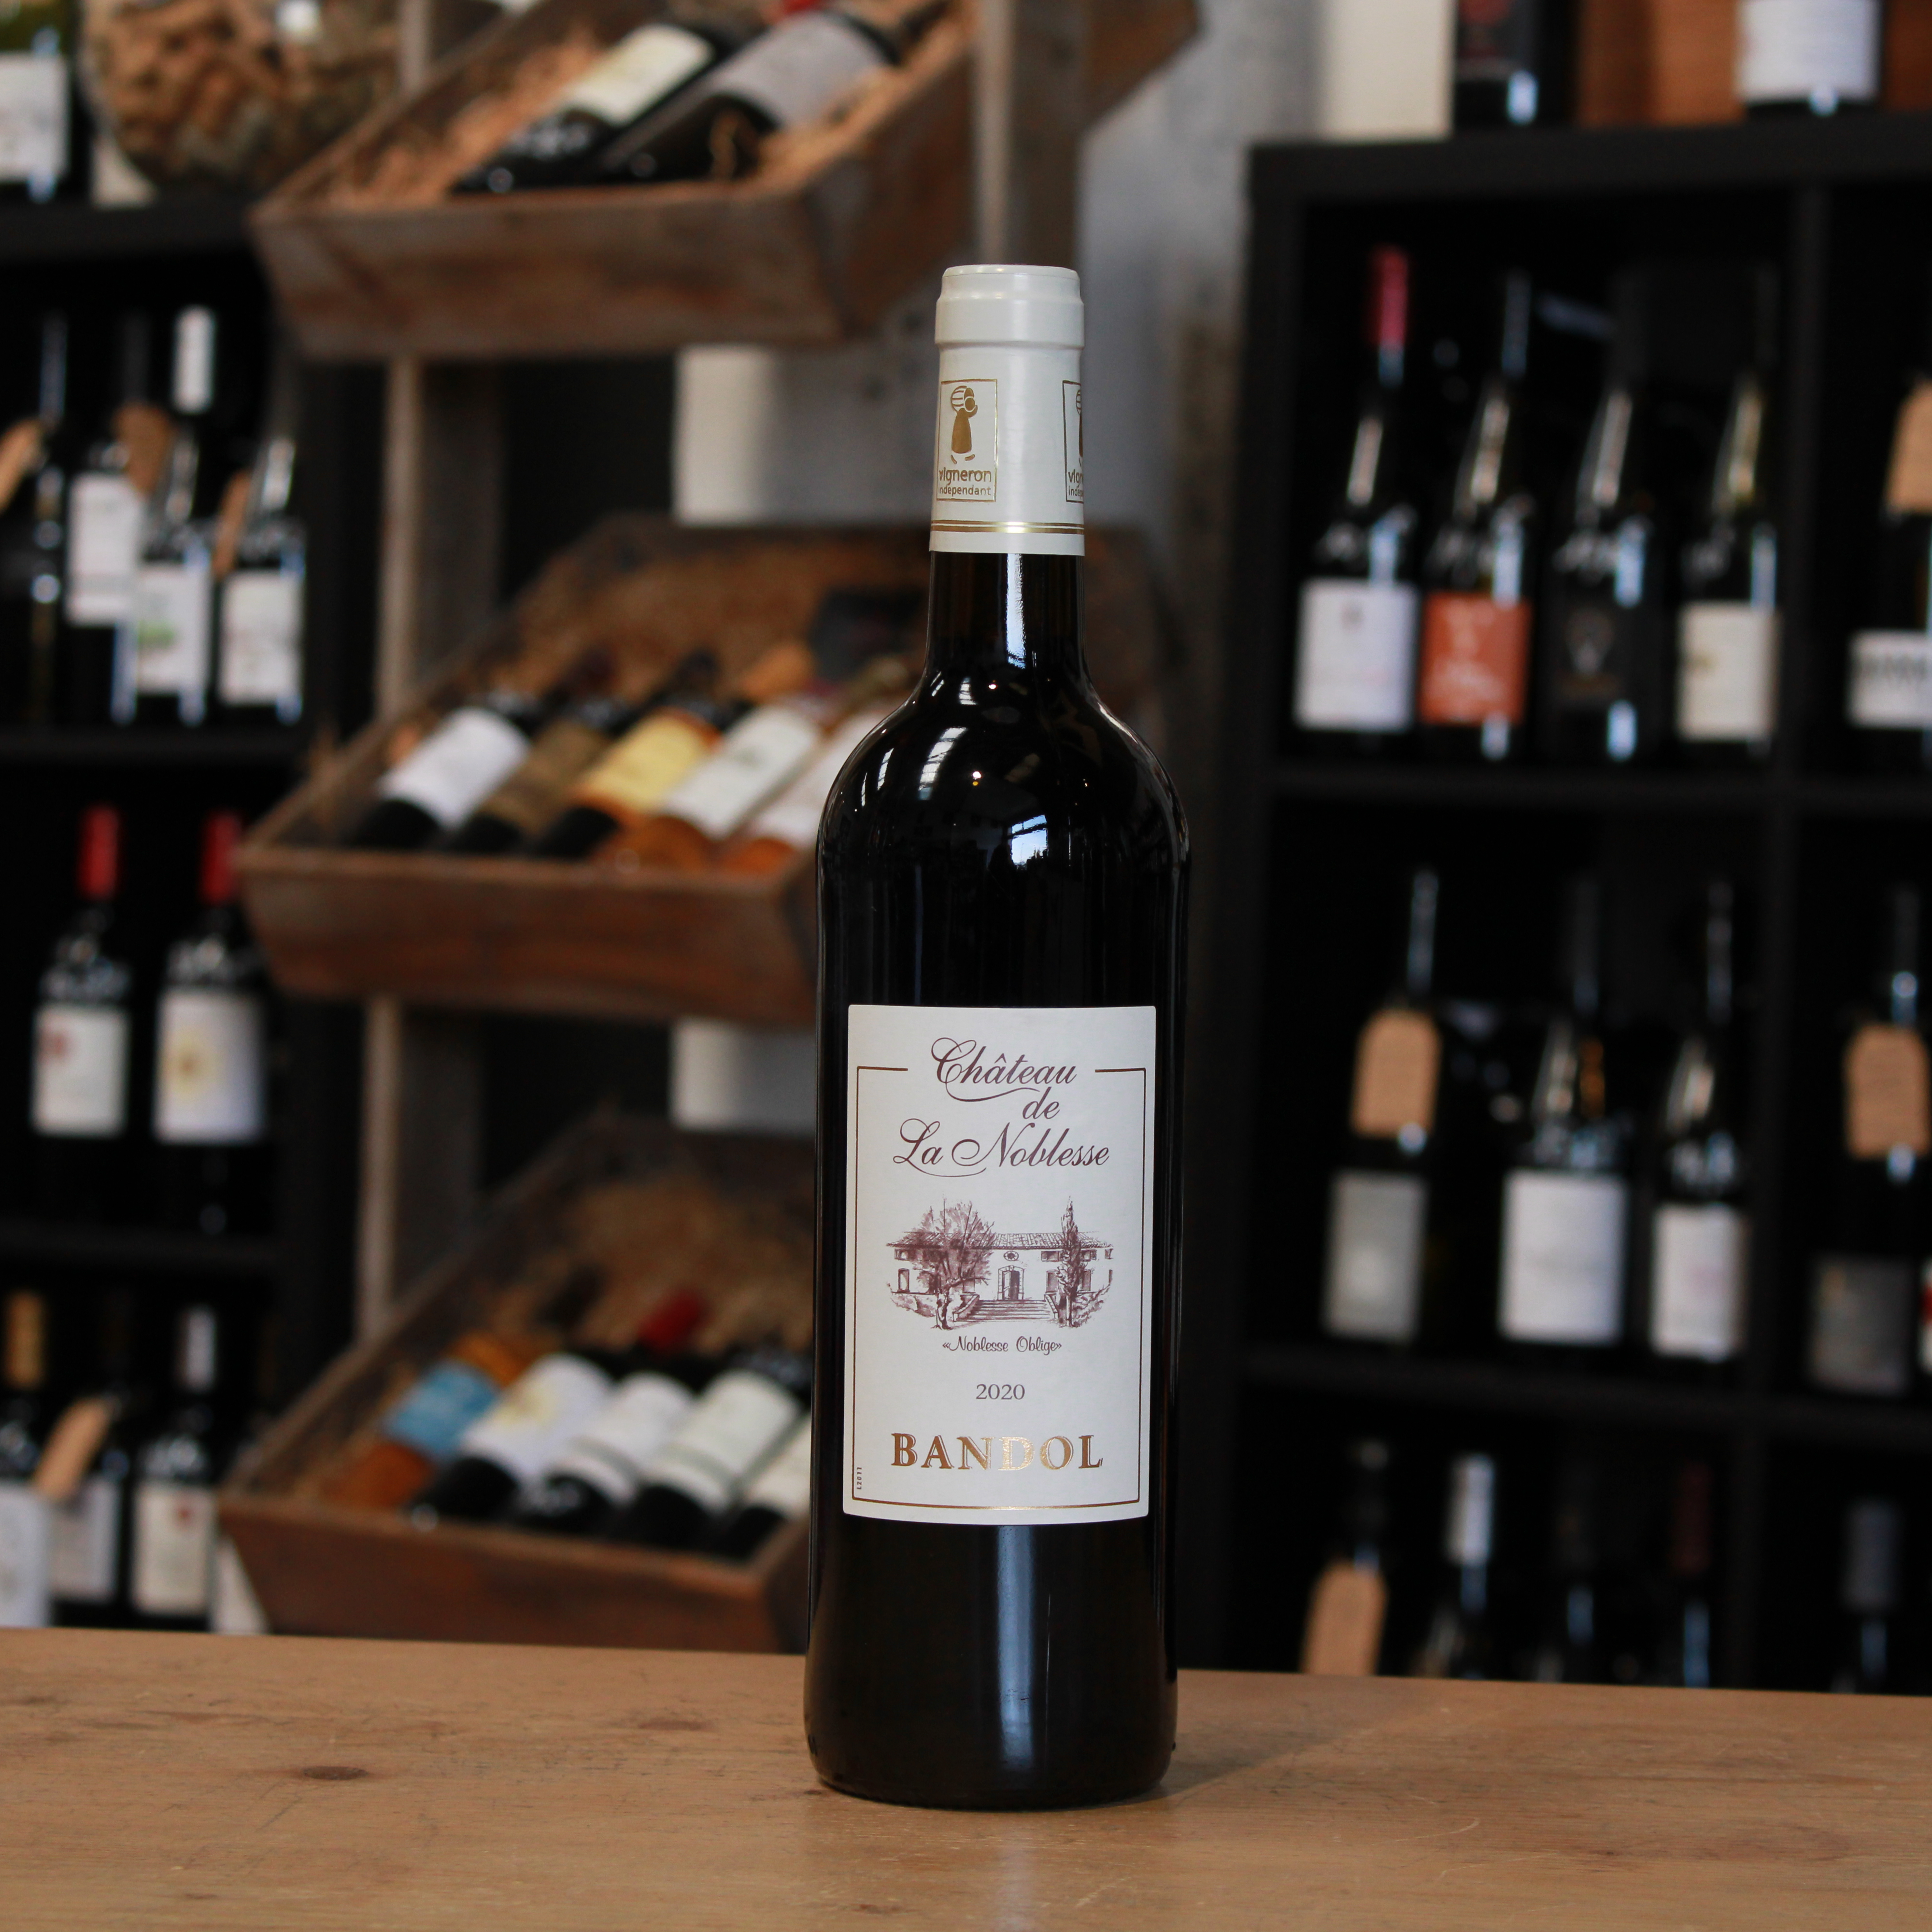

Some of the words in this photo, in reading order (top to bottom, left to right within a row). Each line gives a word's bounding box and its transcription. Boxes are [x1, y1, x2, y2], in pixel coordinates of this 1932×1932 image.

[938, 467, 992, 485] vigneron
[931, 1037, 1077, 1102] Château
[1022, 1086, 1060, 1120] de
[893, 1118, 987, 1178] La
[951, 1122, 1110, 1167] Noblesse
[976, 1384, 1025, 1400] 2020
[891, 1432, 1104, 1470] BANDOL
